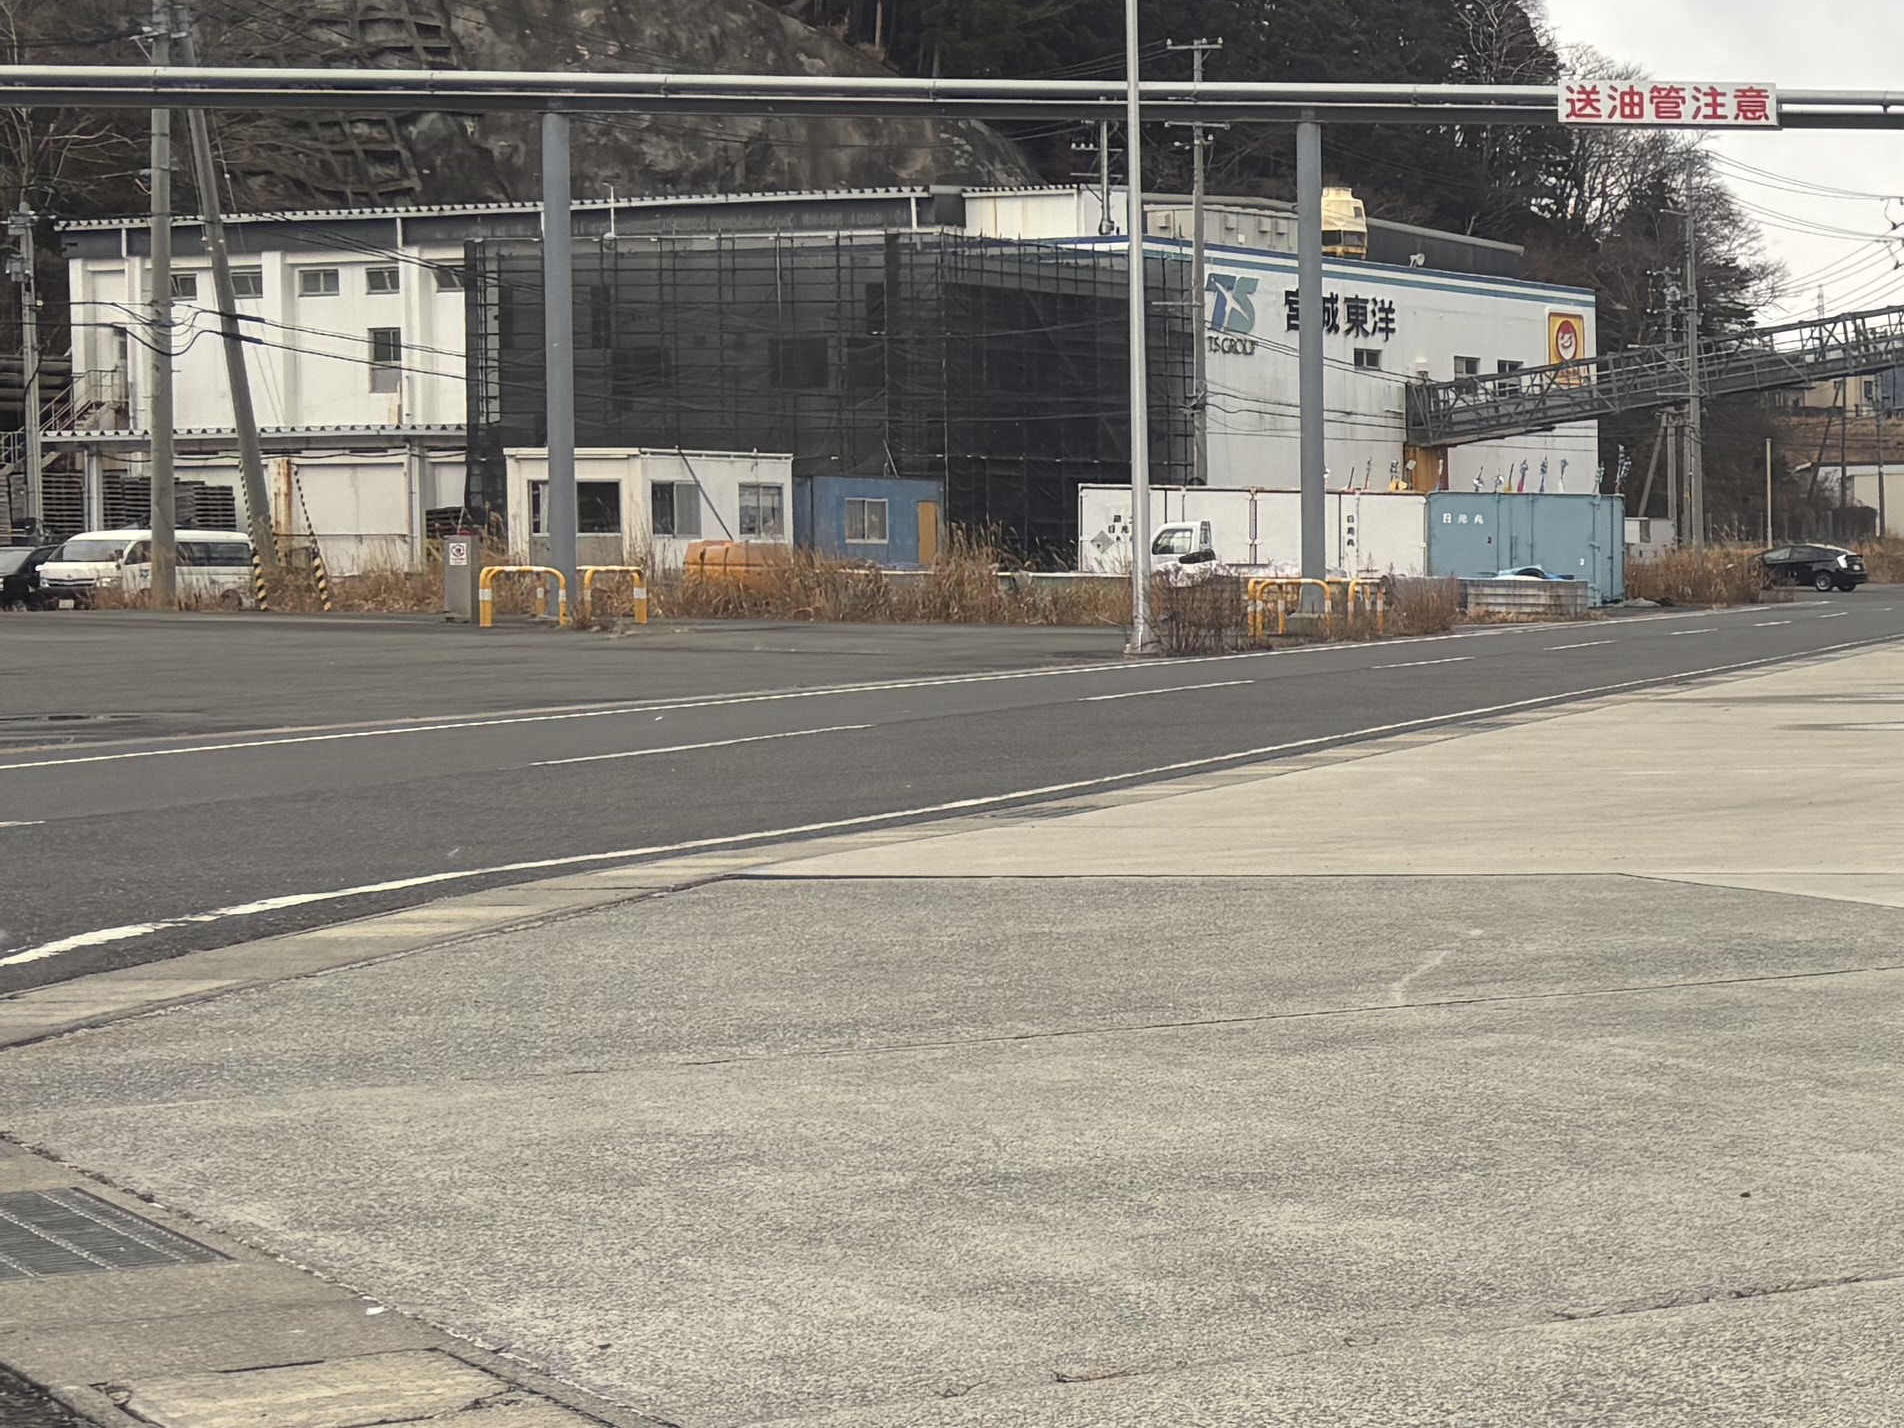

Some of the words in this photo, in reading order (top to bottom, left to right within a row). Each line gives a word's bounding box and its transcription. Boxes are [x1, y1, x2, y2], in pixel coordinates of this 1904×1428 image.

[1565, 85, 1770, 122] 送油管注意
